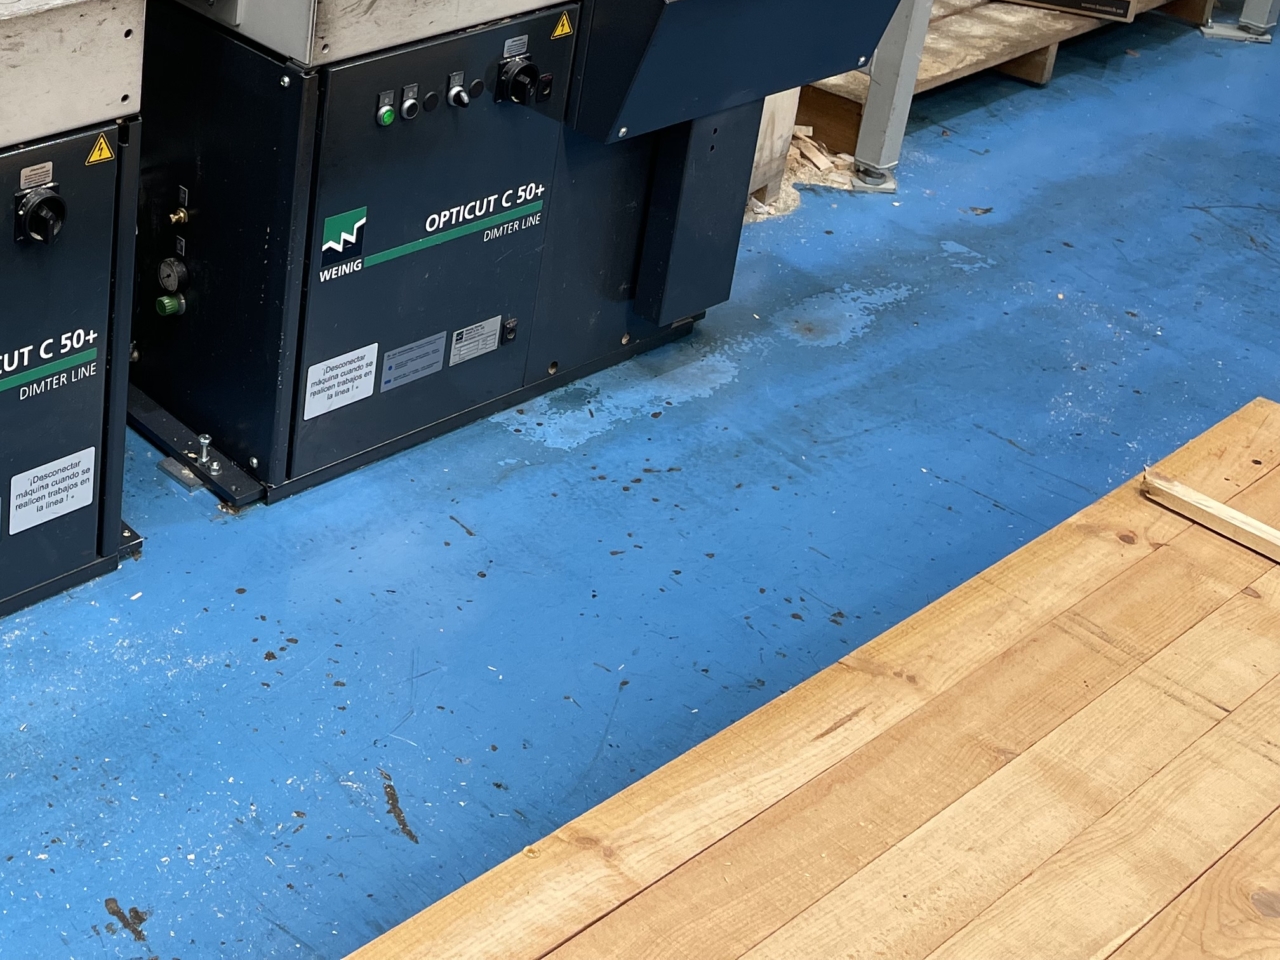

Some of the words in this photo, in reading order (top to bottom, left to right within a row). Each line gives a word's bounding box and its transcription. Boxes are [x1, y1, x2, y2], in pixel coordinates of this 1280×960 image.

[425, 194, 498, 232] OPTICUT
[501, 190, 513, 208] C
[516, 182, 545, 204] 50+
[483, 221, 520, 242] DIMTER
[522, 213, 542, 230] LINE
[319, 259, 362, 283] WEINIG
[40, 338, 54, 359] C
[60, 328, 98, 354] 50+
[19, 372, 68, 401] DIMTER
[71, 362, 97, 382] LINE
[336, 373, 362, 388] trabajos
[364, 370, 372, 378] en
[340, 364, 364, 377] cuando
[15, 483, 49, 500] máquina
[50, 471, 80, 486] cuando
[81, 467, 90, 476] se
[15, 494, 46, 511] realicen
[48, 482, 78, 498] trabajos
[80, 477, 90, 486] en
[36, 504, 44, 512] la
